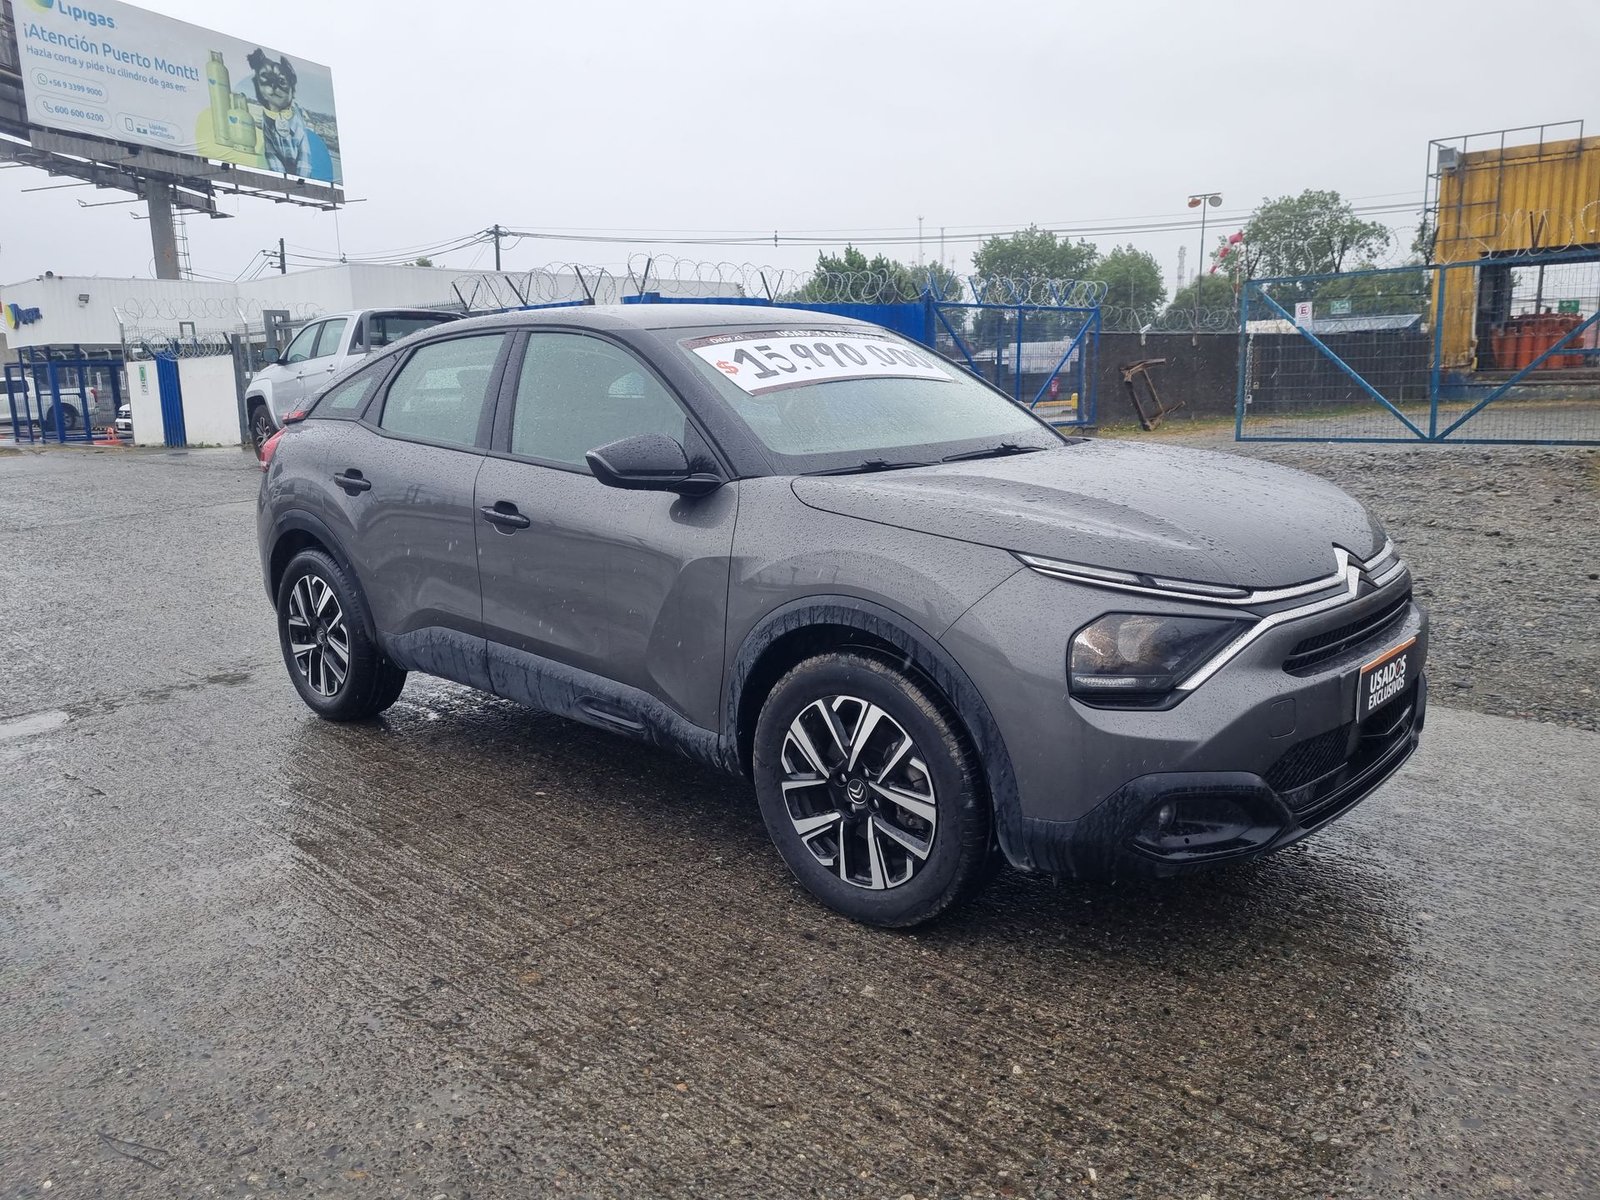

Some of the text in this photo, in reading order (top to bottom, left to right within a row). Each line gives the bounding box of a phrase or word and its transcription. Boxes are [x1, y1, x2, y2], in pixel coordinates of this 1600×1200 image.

[58, 0, 115, 28] Lipigas
[23, 22, 200, 82] ¡Atención Puerto Montt!
[26, 45, 52, 59] Hazla
[54, 53, 77, 65] corta
[77, 60, 84, 68] y
[86, 60, 105, 72] pide
[106, 65, 116, 75] tu
[117, 68, 148, 83] cilindro
[149, 77, 159, 86] de
[160, 80, 174, 90] gas
[49, 79, 62, 88] +56
[68, 82, 85, 93] 3399
[86, 86, 103, 97] 9000
[54, 105, 105, 122] 600 600 6200
[1368, 674, 1405, 711] EXCLUSIVOS
[1370, 654, 1407, 694] USADOS
